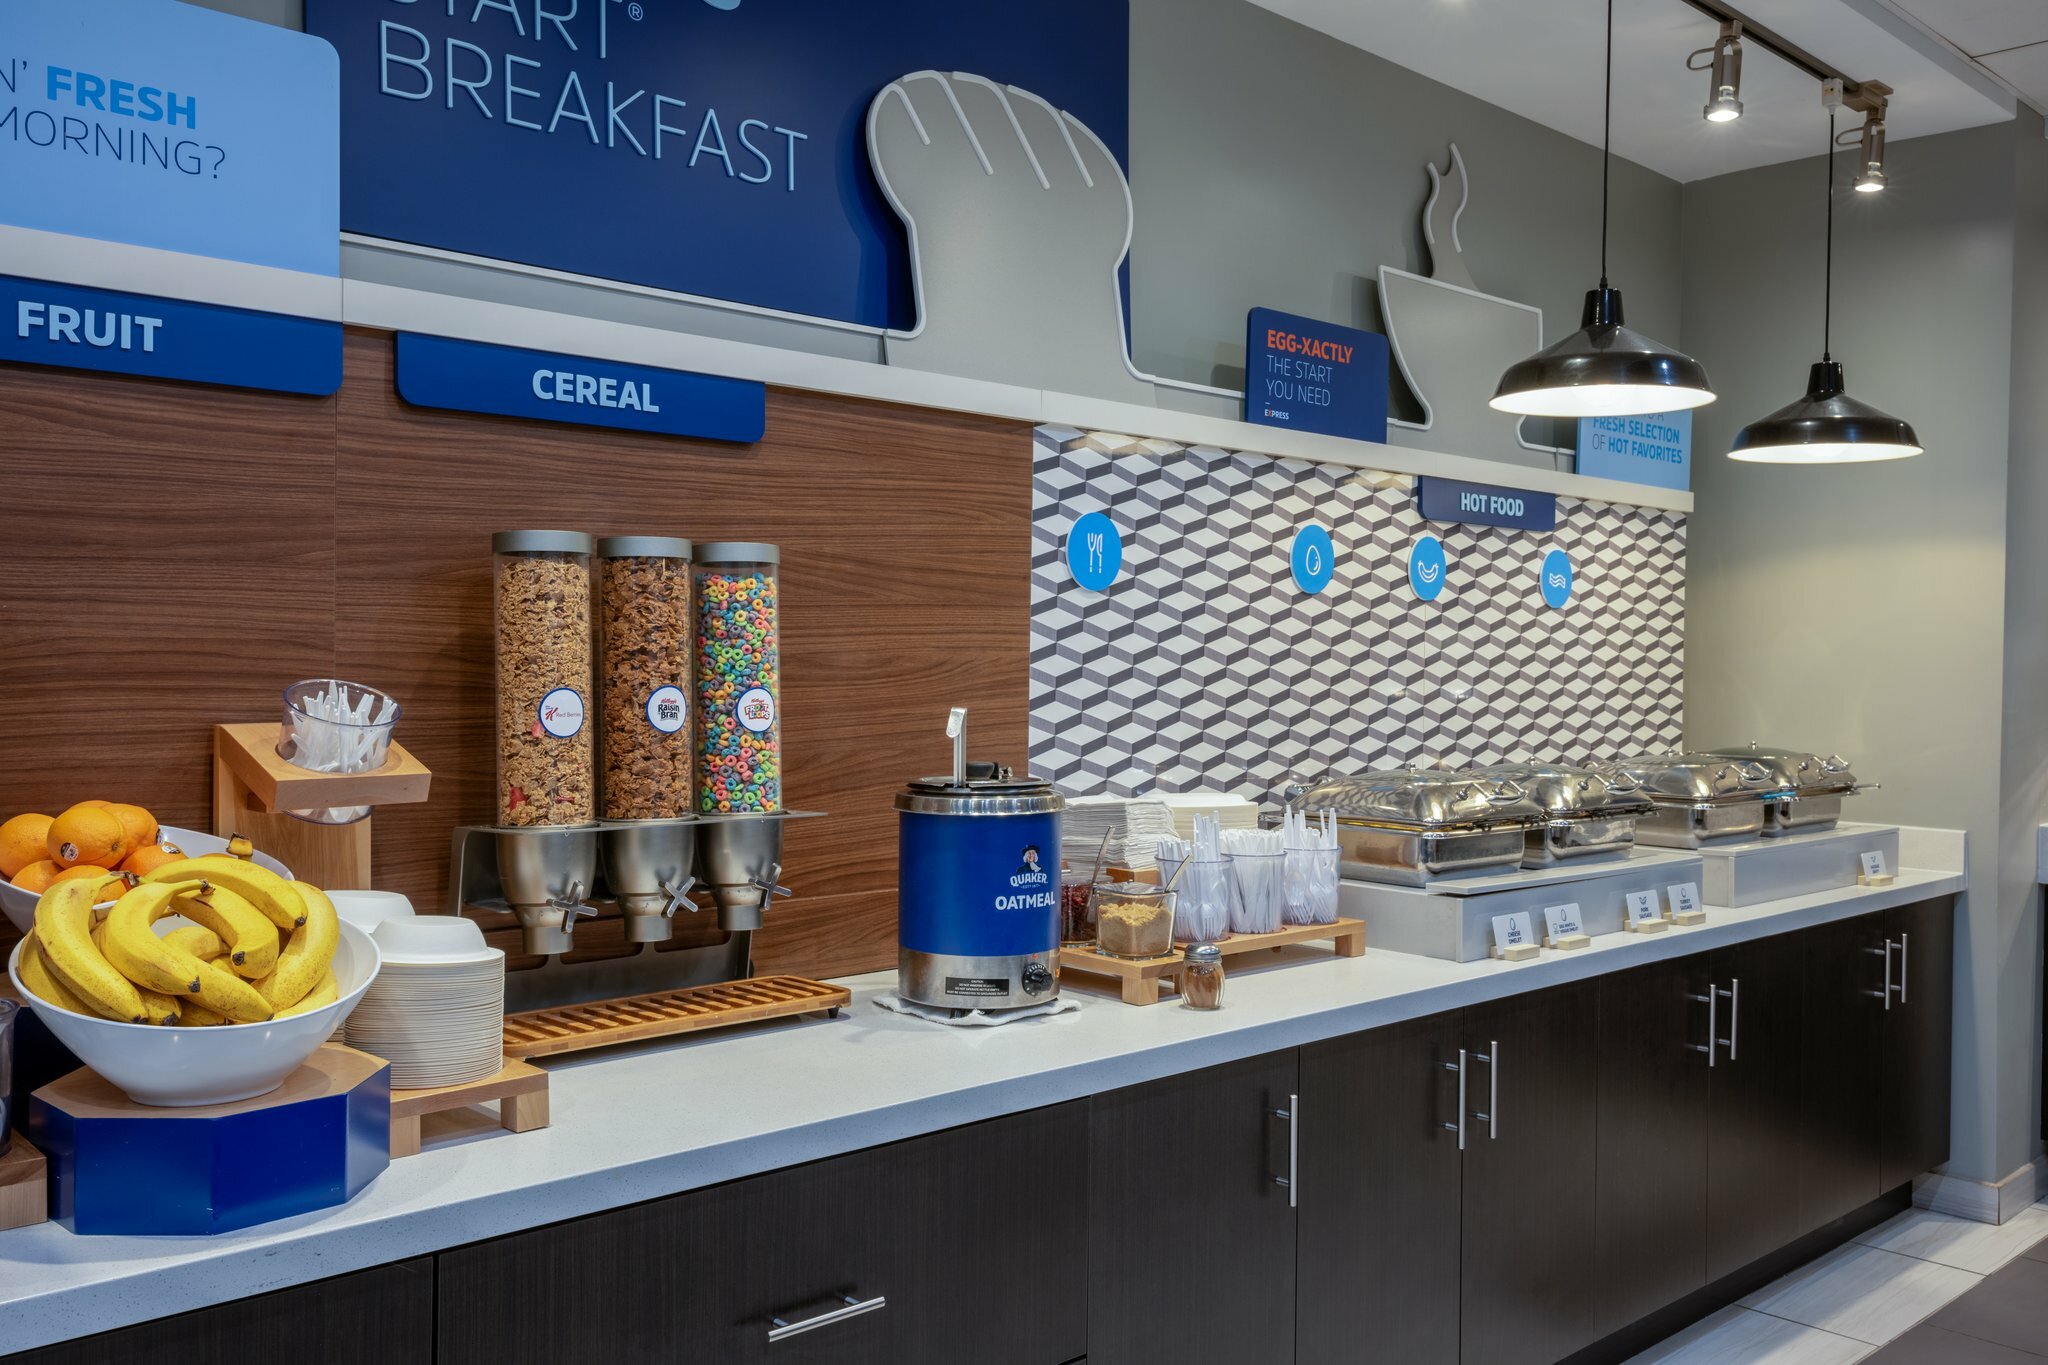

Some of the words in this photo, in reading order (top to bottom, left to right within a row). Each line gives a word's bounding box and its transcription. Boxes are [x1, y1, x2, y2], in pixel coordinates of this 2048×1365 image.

[47, 65, 196, 130] FRESH
[379, 19, 808, 191] BREAKFAST
[18, 300, 163, 352] FRUIT
[1267, 329, 1353, 364] EGG-XACTLY
[1266, 354, 1291, 377] THE
[1295, 361, 1333, 384] START
[532, 369, 660, 413] CEREAL
[1266, 378, 1293, 400] YOU
[1298, 385, 1331, 406] NEED
[1264, 408, 1289, 420] EXPRESS
[1592, 416, 1626, 434] FRESH
[1628, 419, 1680, 444] SELECTION
[1592, 433, 1606, 450] OF
[1608, 436, 1629, 455] HOT
[1631, 440, 1682, 465] FAVORITES
[1461, 492, 1487, 513] HOT
[1490, 496, 1524, 517] FOOD
[657, 703, 680, 713] Raisin
[661, 711, 678, 719] Bran
[1010, 872, 1048, 887] QUAKER
[995, 891, 1055, 910] OATMEAL
